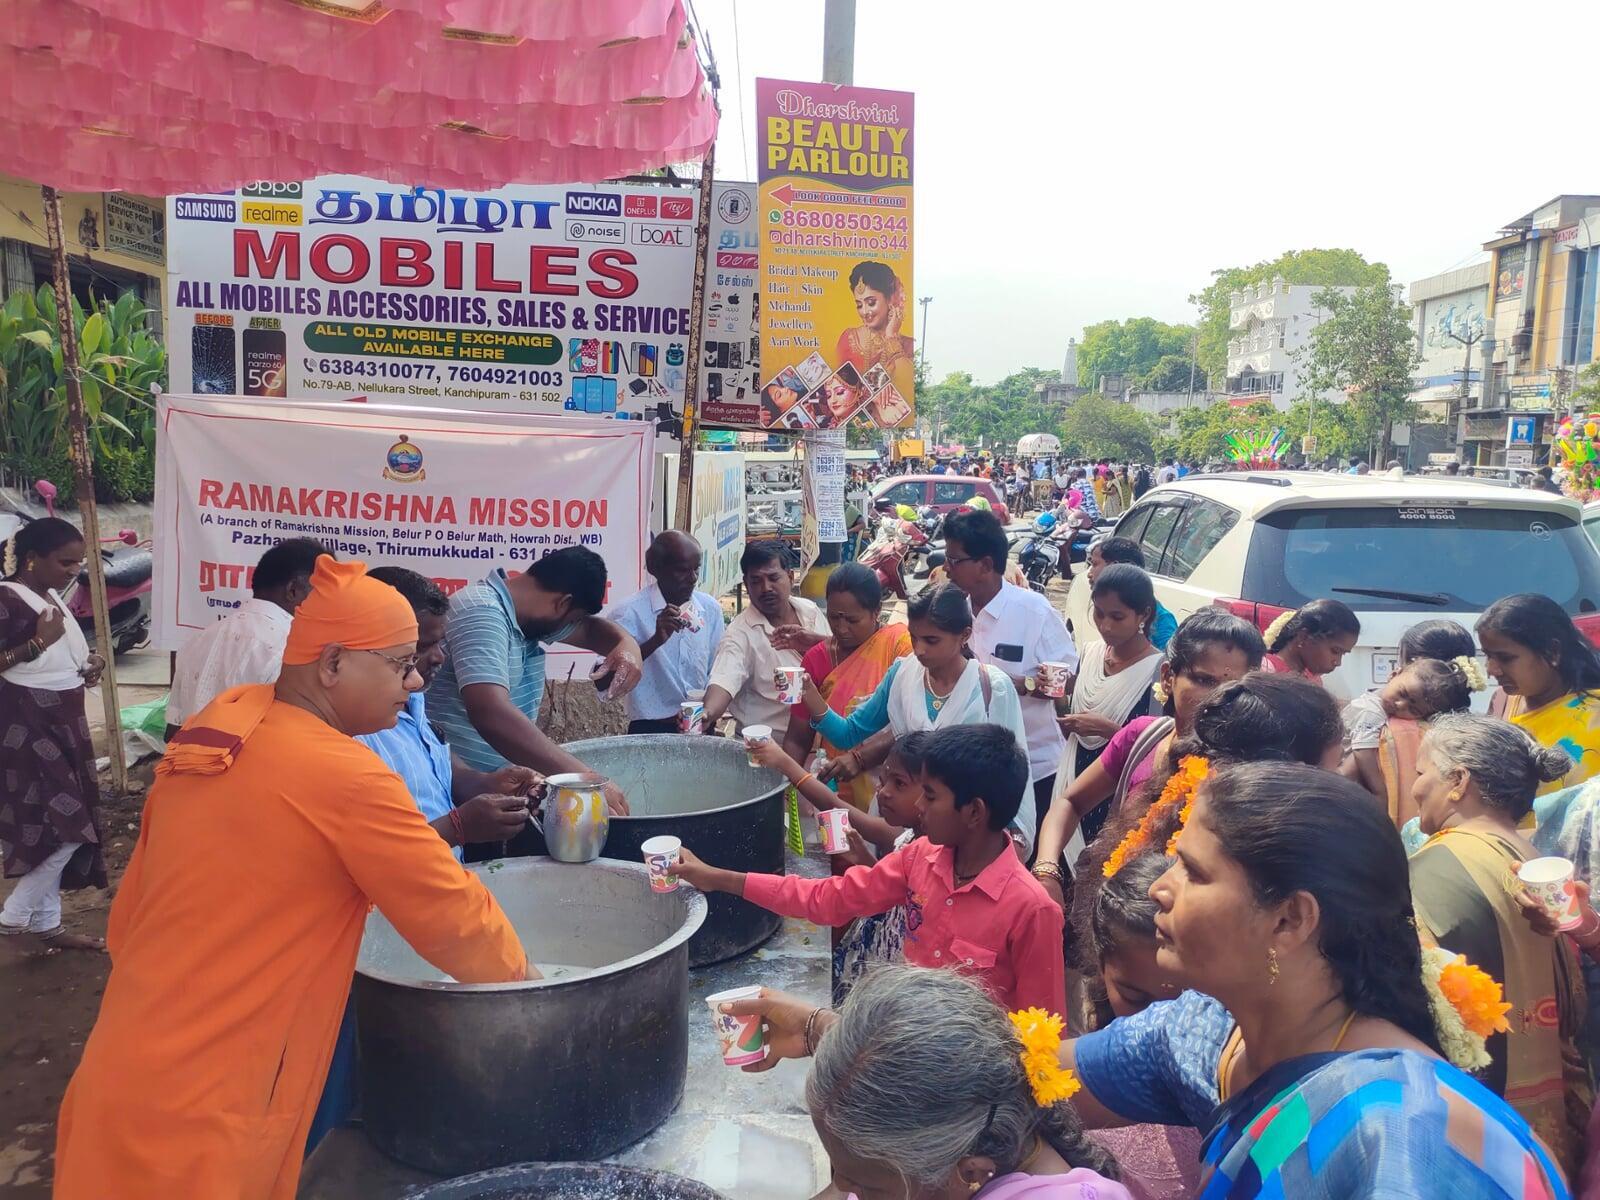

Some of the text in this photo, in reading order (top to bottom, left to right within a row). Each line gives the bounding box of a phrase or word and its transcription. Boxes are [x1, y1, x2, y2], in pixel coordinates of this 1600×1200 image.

[776, 89, 899, 124] Dharshvini
[767, 116, 909, 154] BEAUTY
[767, 145, 909, 179] PARLOUR
[568, 196, 618, 211] NOKIA
[795, 191, 821, 201] LOOK
[824, 193, 849, 203] GOOD
[877, 197, 902, 207] GOOD
[177, 201, 234, 219] SAMSUNG
[246, 205, 298, 222] realme
[309, 186, 560, 233] தமிழா
[626, 207, 656, 216] ONEPLUS
[783, 210, 908, 233] 8680850344
[233, 229, 639, 299] MOBILES
[768, 264, 839, 281] Bridal Makeup
[768, 282, 823, 296] Hair Skin
[176, 281, 690, 336] ALL MOBILES ACCESSORIES, SALES & SERVICE
[768, 300, 811, 312] Mehandi
[194, 313, 234, 327] BEFORE
[250, 317, 281, 329] AFTER
[314, 324, 553, 348] ALL OLD MOBILE EXCHANGE
[769, 337, 820, 348] Aari Work
[248, 351, 282, 361] realme
[363, 341, 505, 360] AVAILABLE HERE
[248, 361, 272, 369] narzo
[319, 358, 563, 387] 6384310077, 7604921003
[248, 369, 282, 390] 5G
[303, 380, 355, 393] No.79-AB,
[358, 382, 405, 394] Nellukara
[408, 385, 441, 397] Street,
[444, 387, 510, 400] Kanchipuram
[519, 391, 537, 402] 631
[198, 479, 608, 528] RAMAKRISHNA MISSION
[200, 513, 213, 525] (A
[217, 514, 257, 528] branch
[261, 517, 273, 529] of
[274, 520, 340, 534] Ramakrishna
[343, 525, 389, 539] Mission,
[392, 528, 421, 540] Belur
[424, 530, 431, 540] P
[435, 530, 444, 540] O
[447, 530, 475, 543] Belur
[478, 532, 507, 544] Math,
[510, 533, 551, 545] Howrah
[580, 533, 603, 545] WB)
[376, 542, 494, 560] Thirumukkudal
[509, 547, 536, 560] 631
